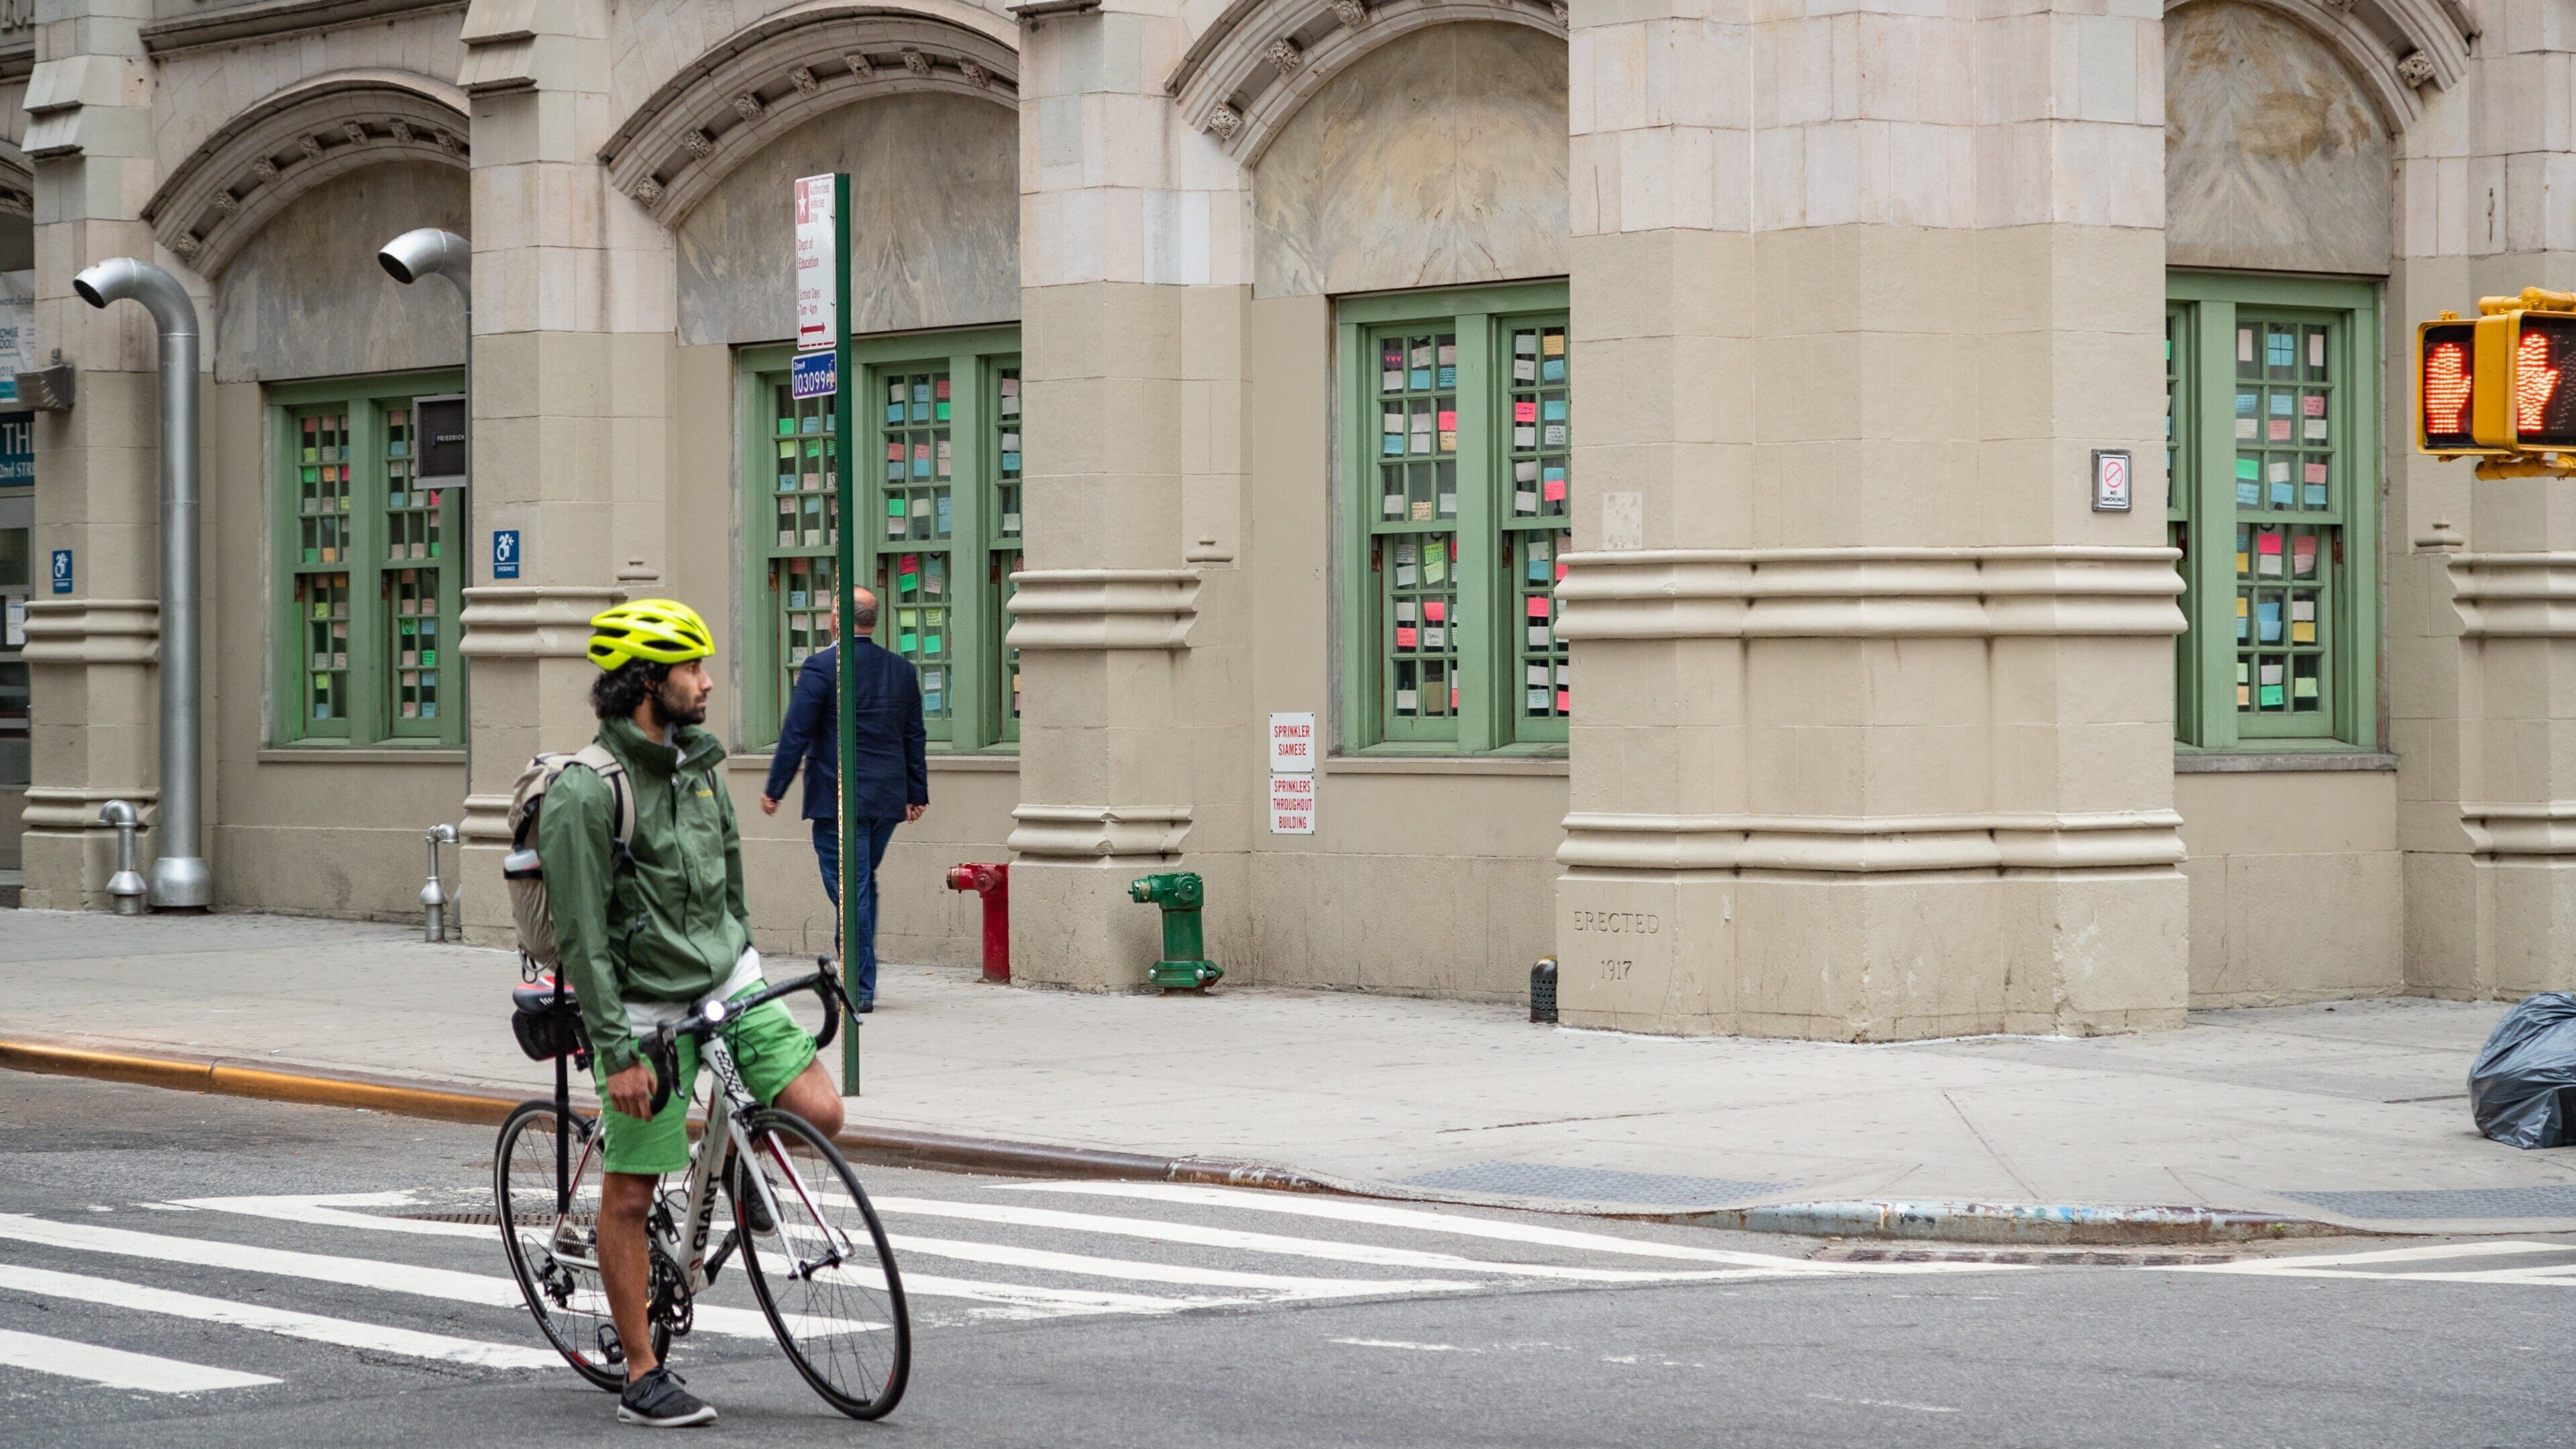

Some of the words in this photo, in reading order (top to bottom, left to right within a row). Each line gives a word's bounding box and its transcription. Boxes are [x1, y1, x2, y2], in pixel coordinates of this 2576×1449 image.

[810, 182, 830, 197] Authorized
[810, 197, 825, 209] Vehicles
[810, 211, 818, 224] Only
[798, 238, 808, 253] Dept
[808, 236, 814, 250] of
[798, 256, 819, 270] Education
[799, 288, 811, 301] School
[811, 286, 820, 301] Days
[809, 303, 818, 317] 4pm
[794, 370, 826, 394] 103099
[2, 422, 35, 455] TH
[437, 433, 465, 441] FRIEDRICH
[1274, 725, 1311, 739] SPRINKLER
[1279, 743, 1307, 756] SIAMESE
[1274, 780, 1311, 793] SPRINKLERS
[1273, 798, 1312, 811] THROUGHOUT
[1279, 816, 1307, 829] BUILDING
[1573, 910, 1660, 934] ERECTED
[1601, 959, 1633, 981] 1917
[692, 1171, 720, 1252] GIANT
